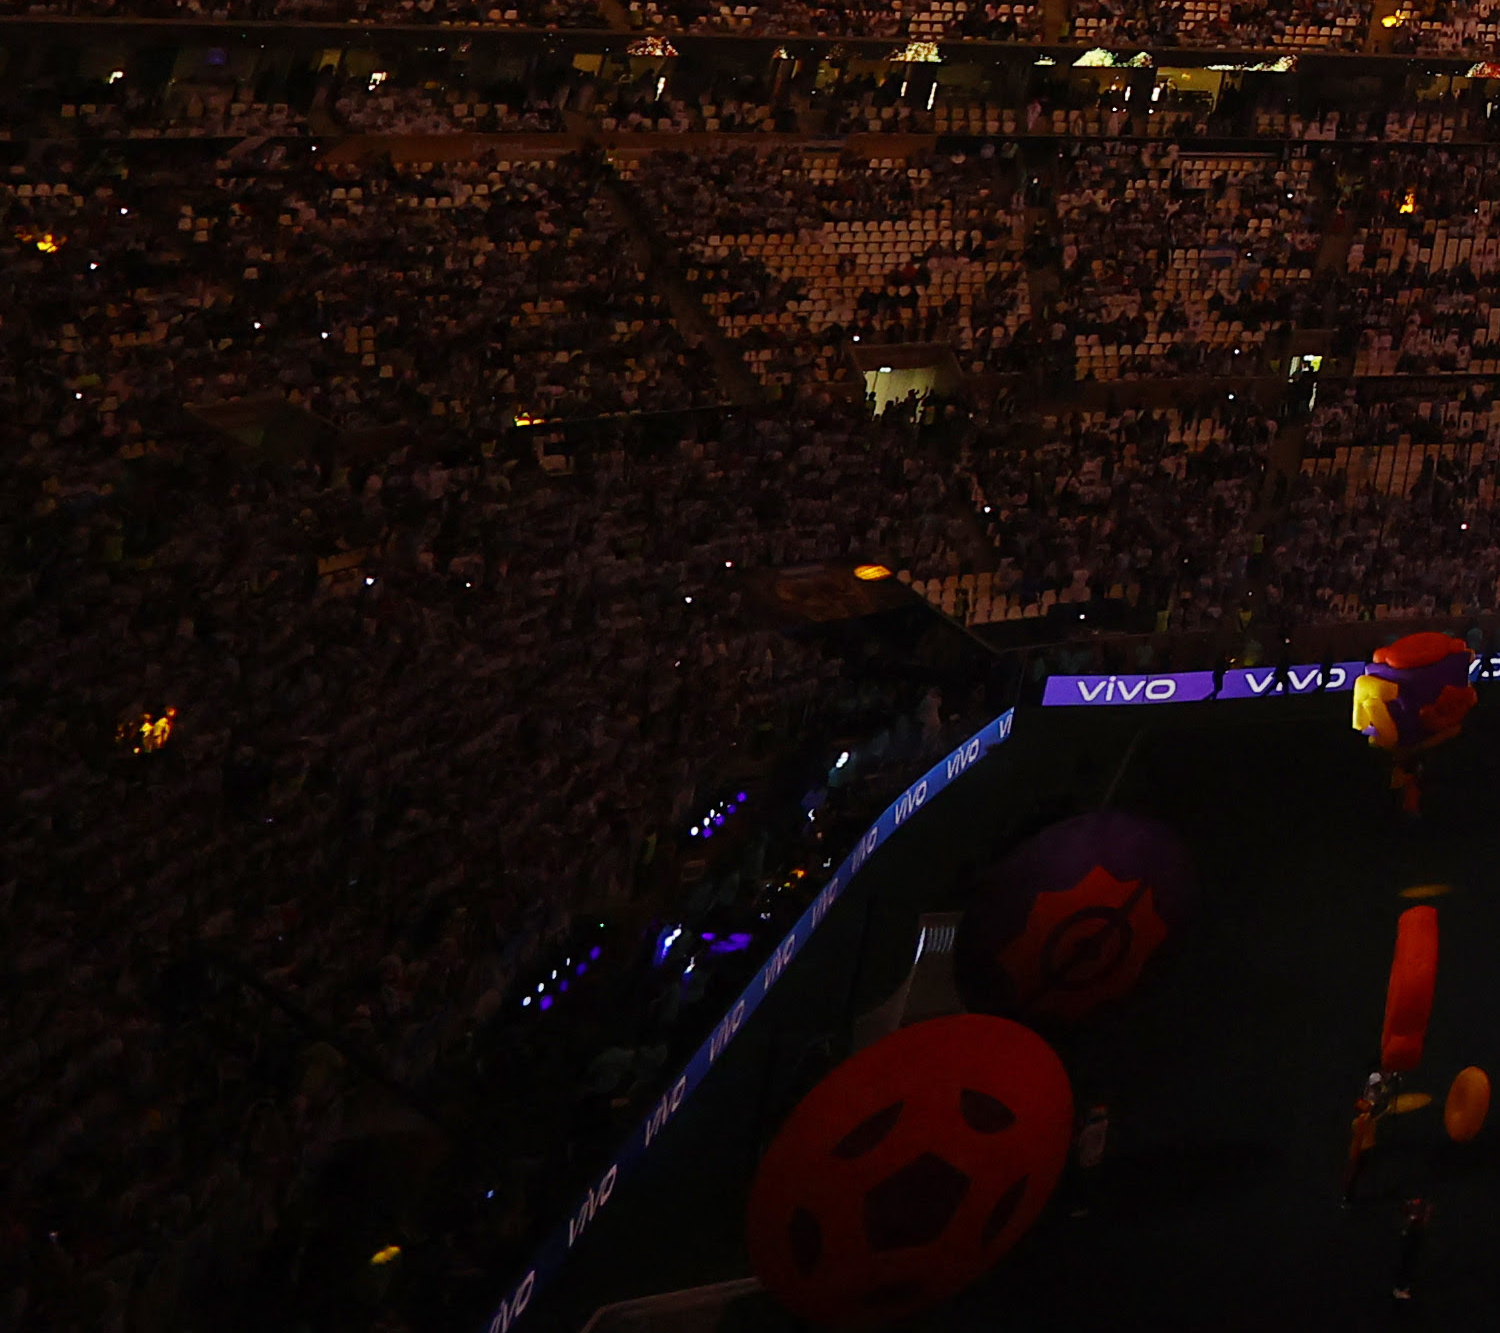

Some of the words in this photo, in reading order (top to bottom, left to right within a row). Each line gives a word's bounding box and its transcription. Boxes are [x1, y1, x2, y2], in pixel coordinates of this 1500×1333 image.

[1078, 676, 1176, 702] vivo
[1245, 668, 1346, 693] vvo
[894, 780, 928, 825] vivo
[946, 738, 980, 780] vivo
